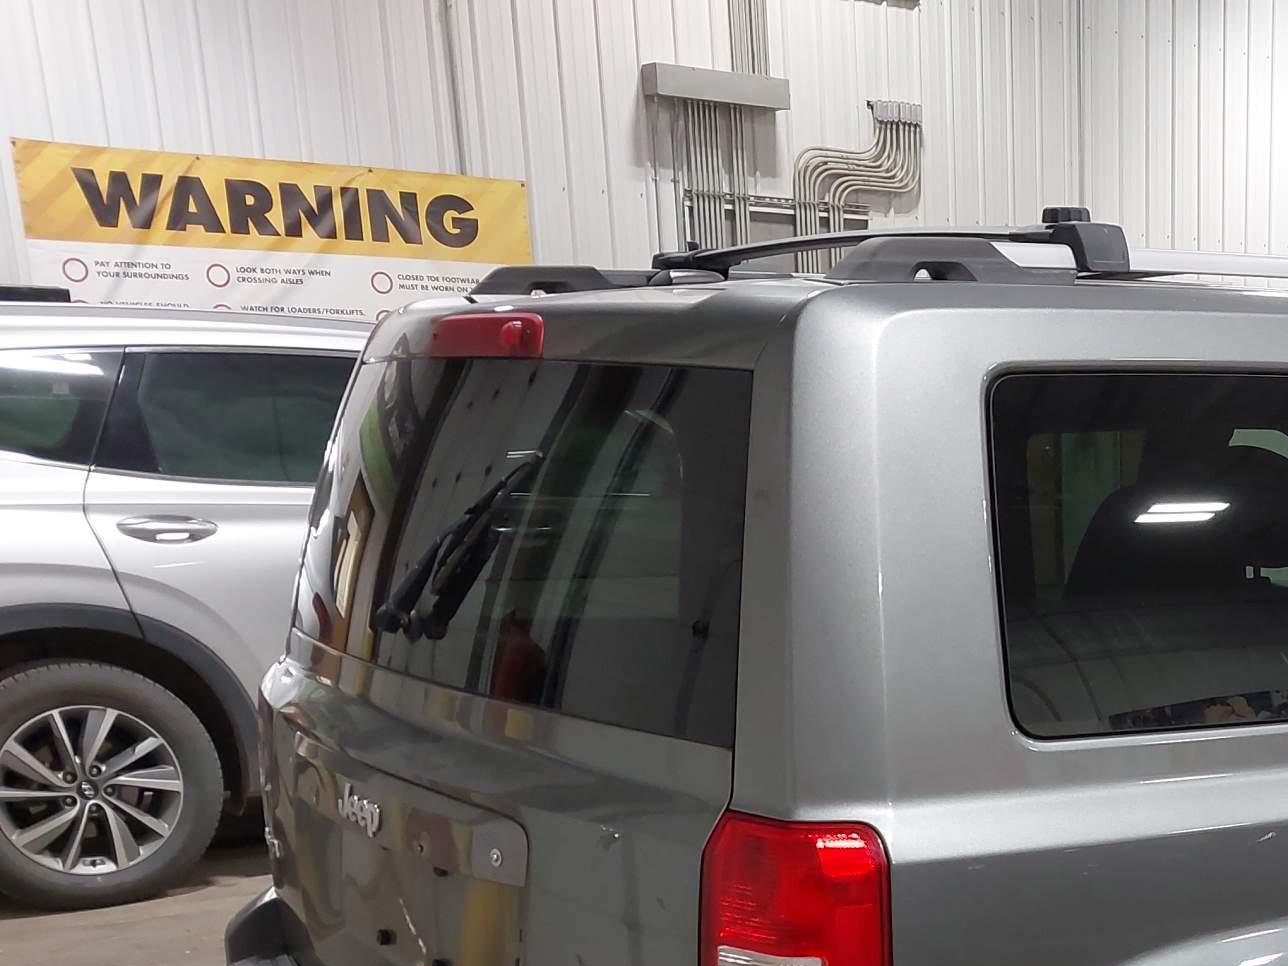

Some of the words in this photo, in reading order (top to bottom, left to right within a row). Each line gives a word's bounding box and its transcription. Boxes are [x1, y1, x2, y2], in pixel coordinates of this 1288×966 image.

[70, 166, 480, 249] WARNING
[114, 261, 158, 269] ATTENTION
[160, 262, 171, 270] TO
[122, 271, 190, 280] SURROUNDINGS
[236, 266, 257, 274] LOOK
[283, 268, 306, 276] WAYS
[308, 269, 331, 277] WHEN
[236, 276, 278, 284] CROSSING
[280, 277, 304, 285] AISLES
[397, 273, 424, 281] CLOSED
[442, 276, 480, 284] FOOTWEAR
[398, 283, 418, 291] MUST
[240, 305, 268, 313] WATCH
[338, 783, 381, 838] Jeep
